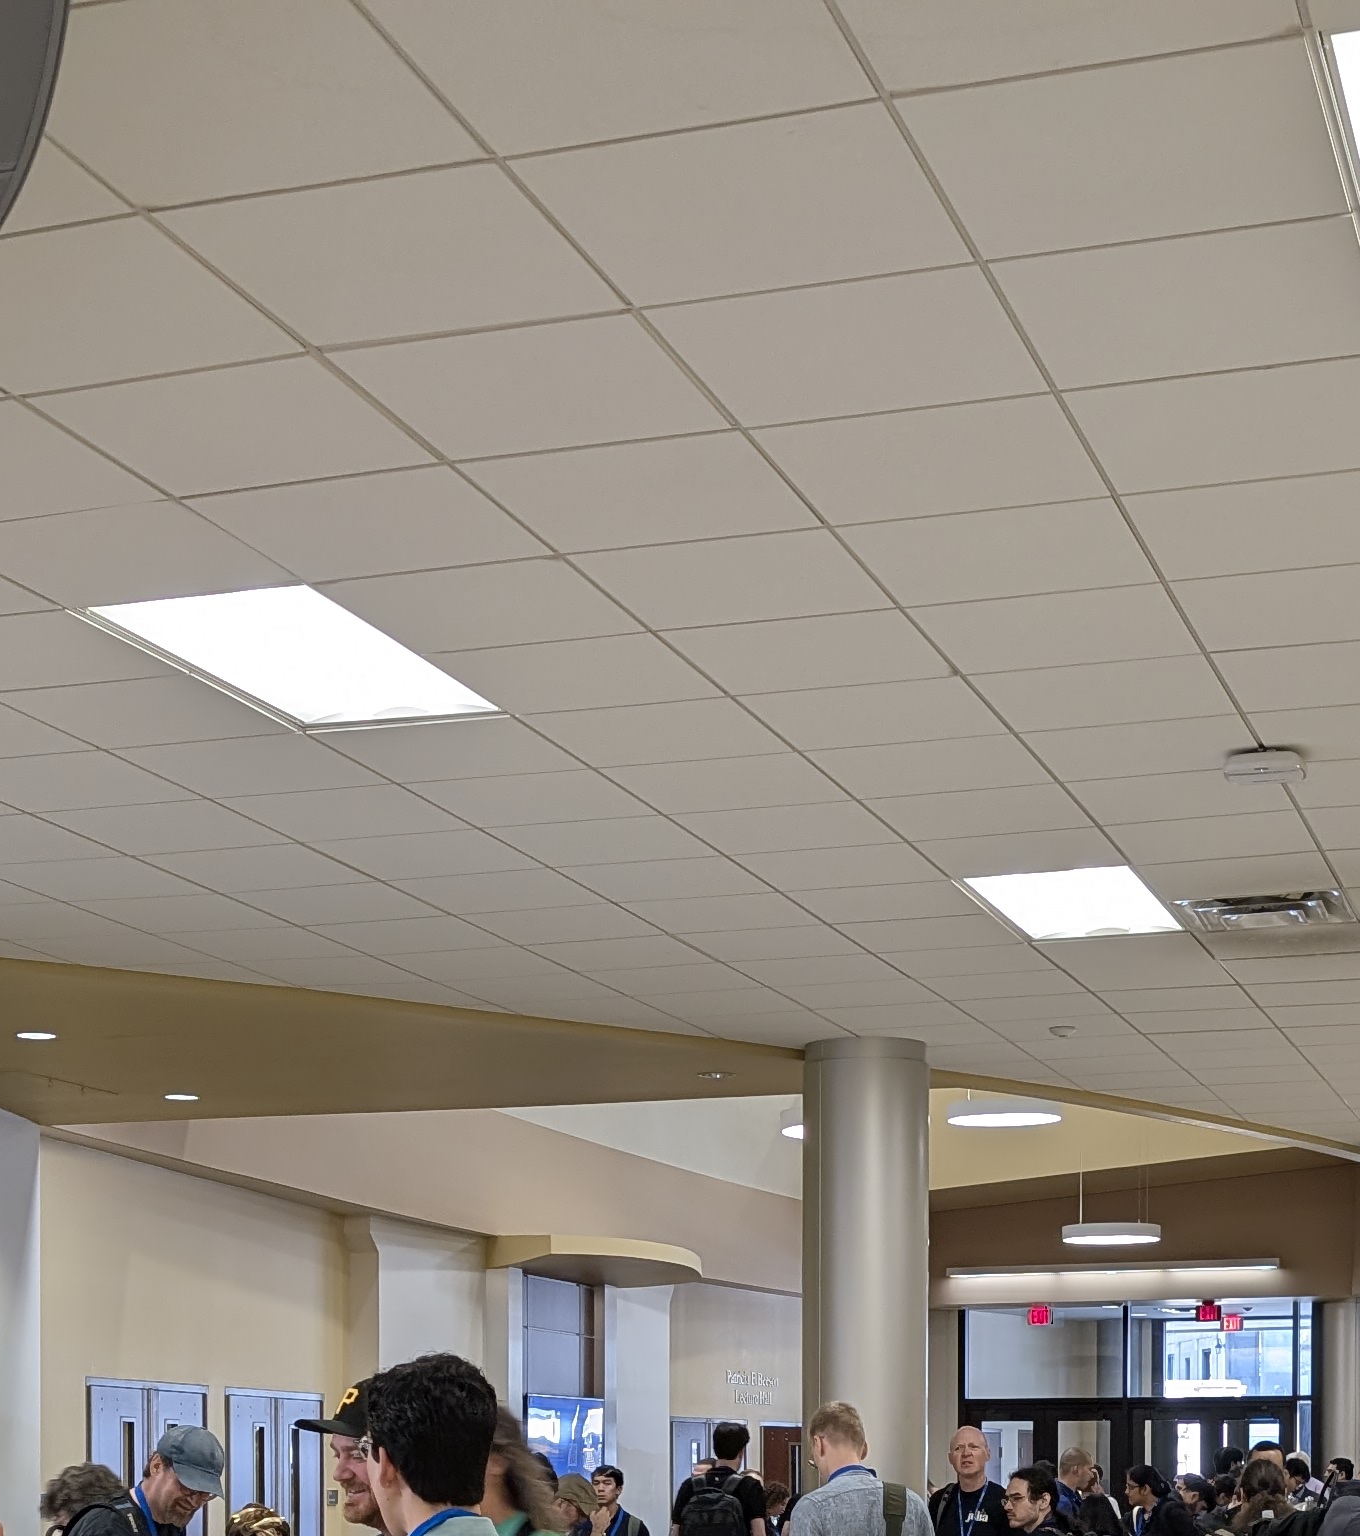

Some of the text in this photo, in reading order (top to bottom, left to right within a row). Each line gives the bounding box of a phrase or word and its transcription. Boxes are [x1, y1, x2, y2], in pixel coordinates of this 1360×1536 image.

[1031, 1308, 1049, 1325] EXIT
[1200, 1307, 1218, 1321] EXIT
[1223, 1317, 1241, 1331] EXIT
[335, 1387, 359, 1414] P
